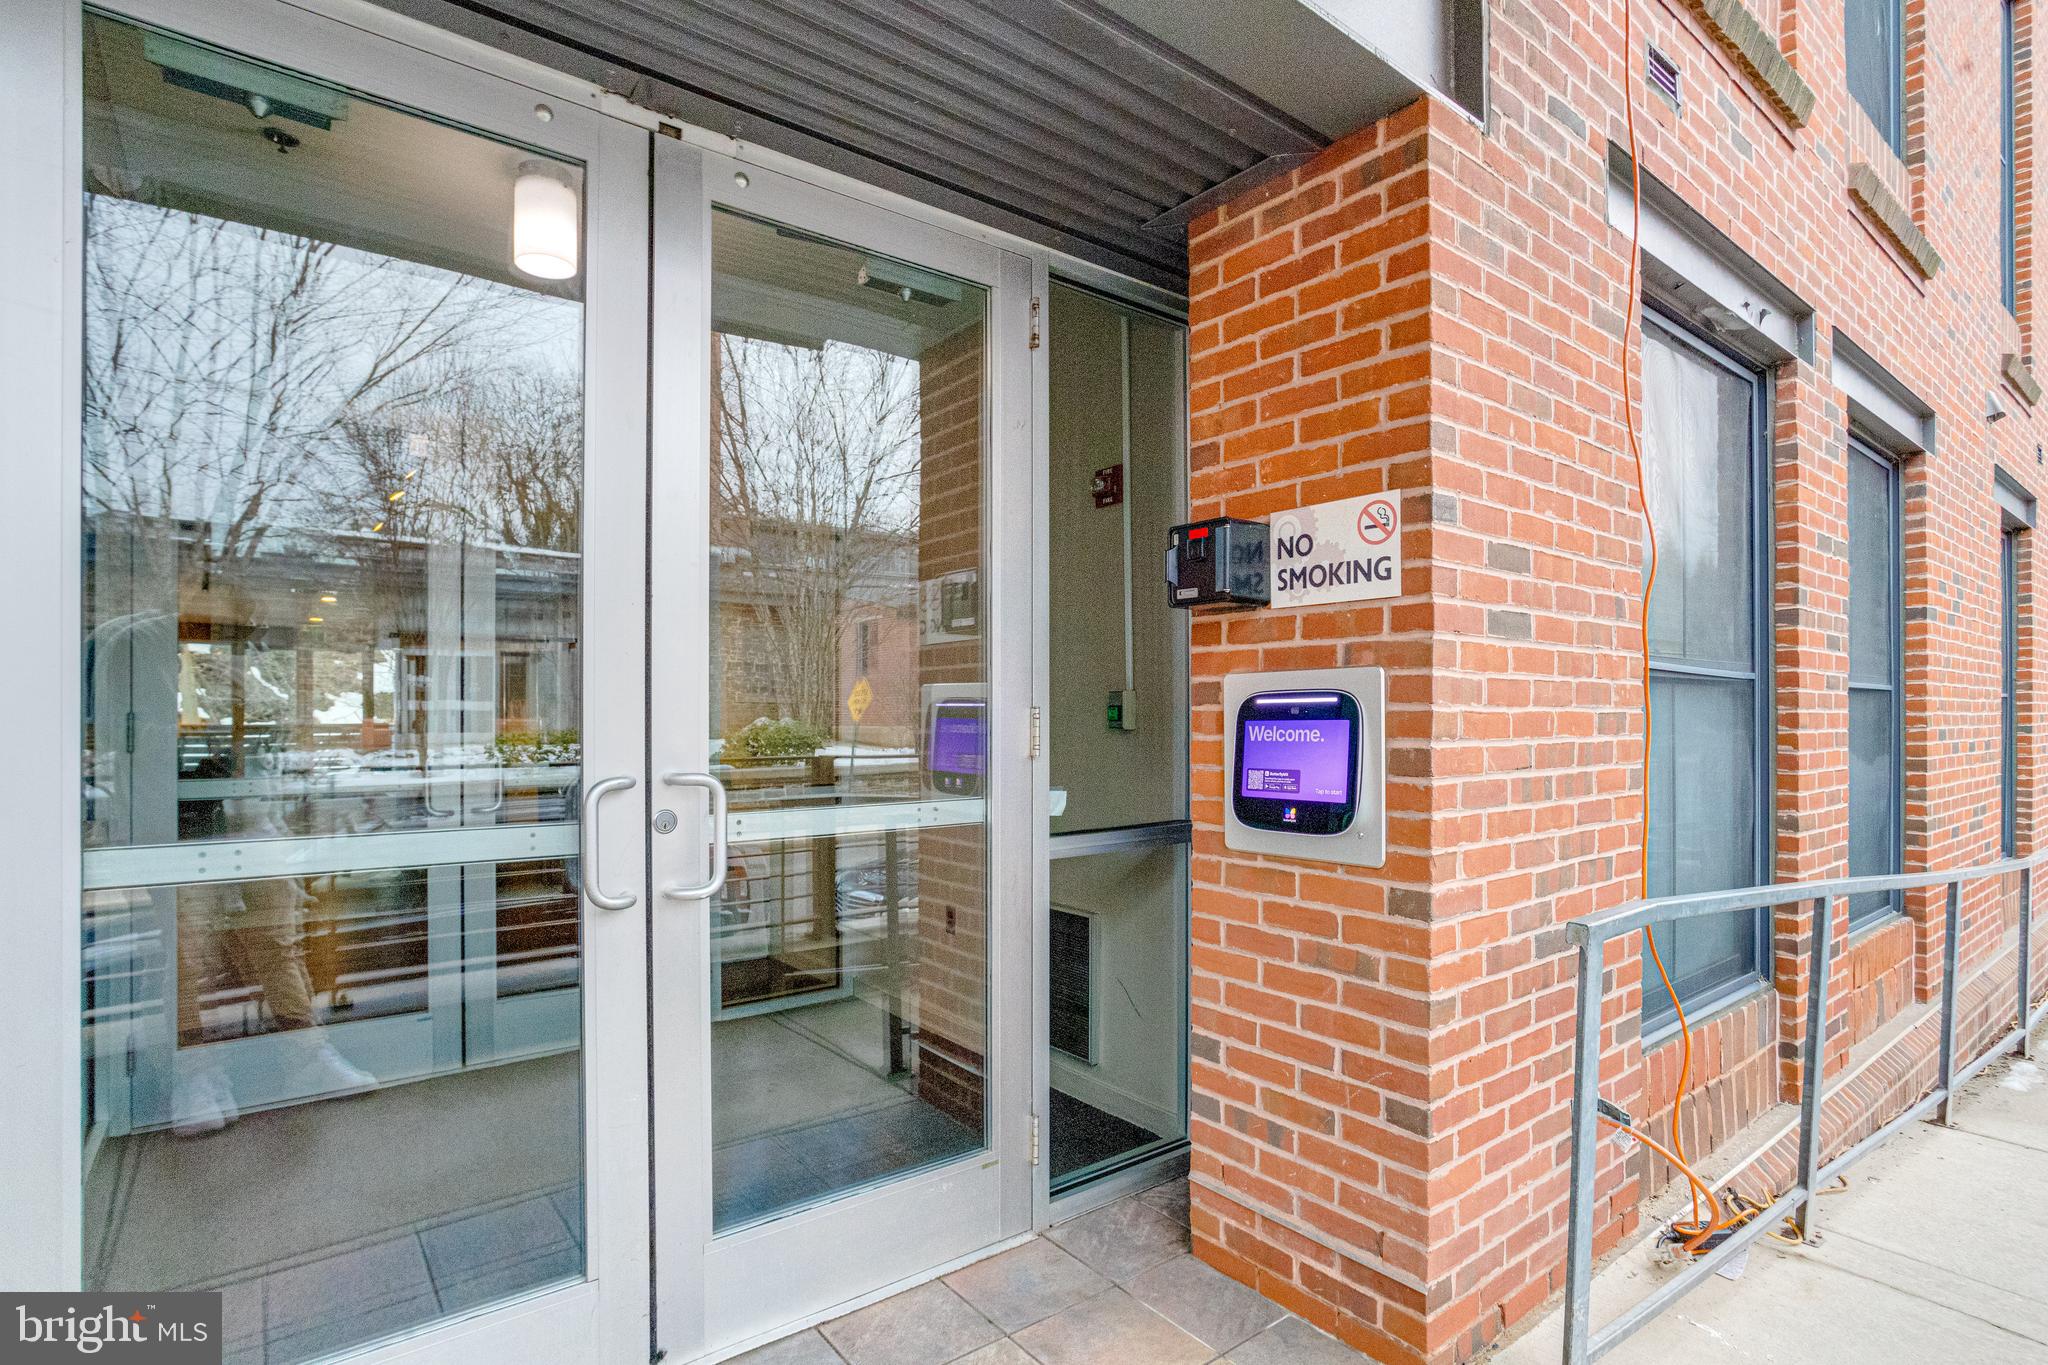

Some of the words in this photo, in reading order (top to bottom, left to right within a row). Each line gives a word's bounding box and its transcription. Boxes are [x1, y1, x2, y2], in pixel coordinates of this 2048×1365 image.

[1277, 533, 1314, 560] NO
[1277, 555, 1393, 592] SMOKING
[1248, 725, 1325, 742] Welcome.
